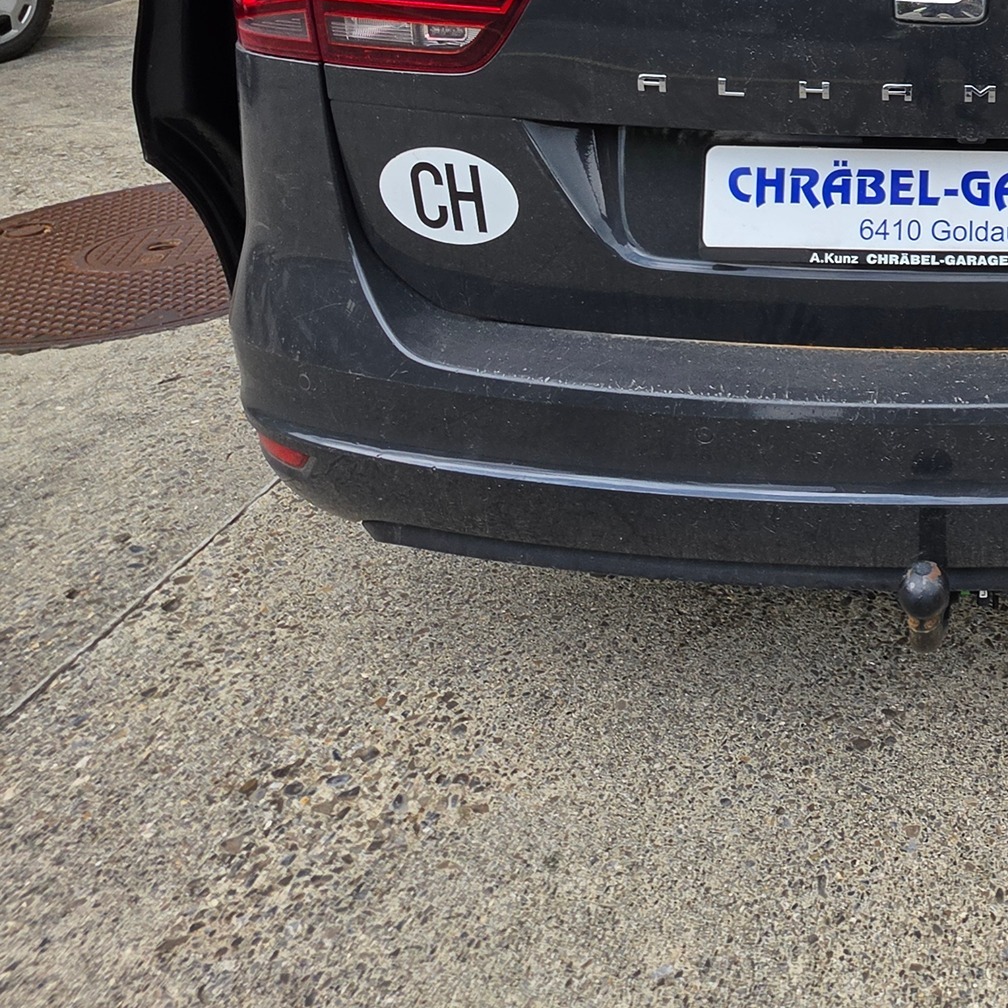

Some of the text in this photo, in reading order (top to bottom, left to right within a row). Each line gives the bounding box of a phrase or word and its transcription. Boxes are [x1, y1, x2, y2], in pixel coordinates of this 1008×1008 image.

[411, 160, 489, 234] CH
[858, 218, 922, 242] 6410
[809, 252, 859, 265] A.Kunz
[866, 252, 1008, 266] CHRÄBEL-GARAGE
